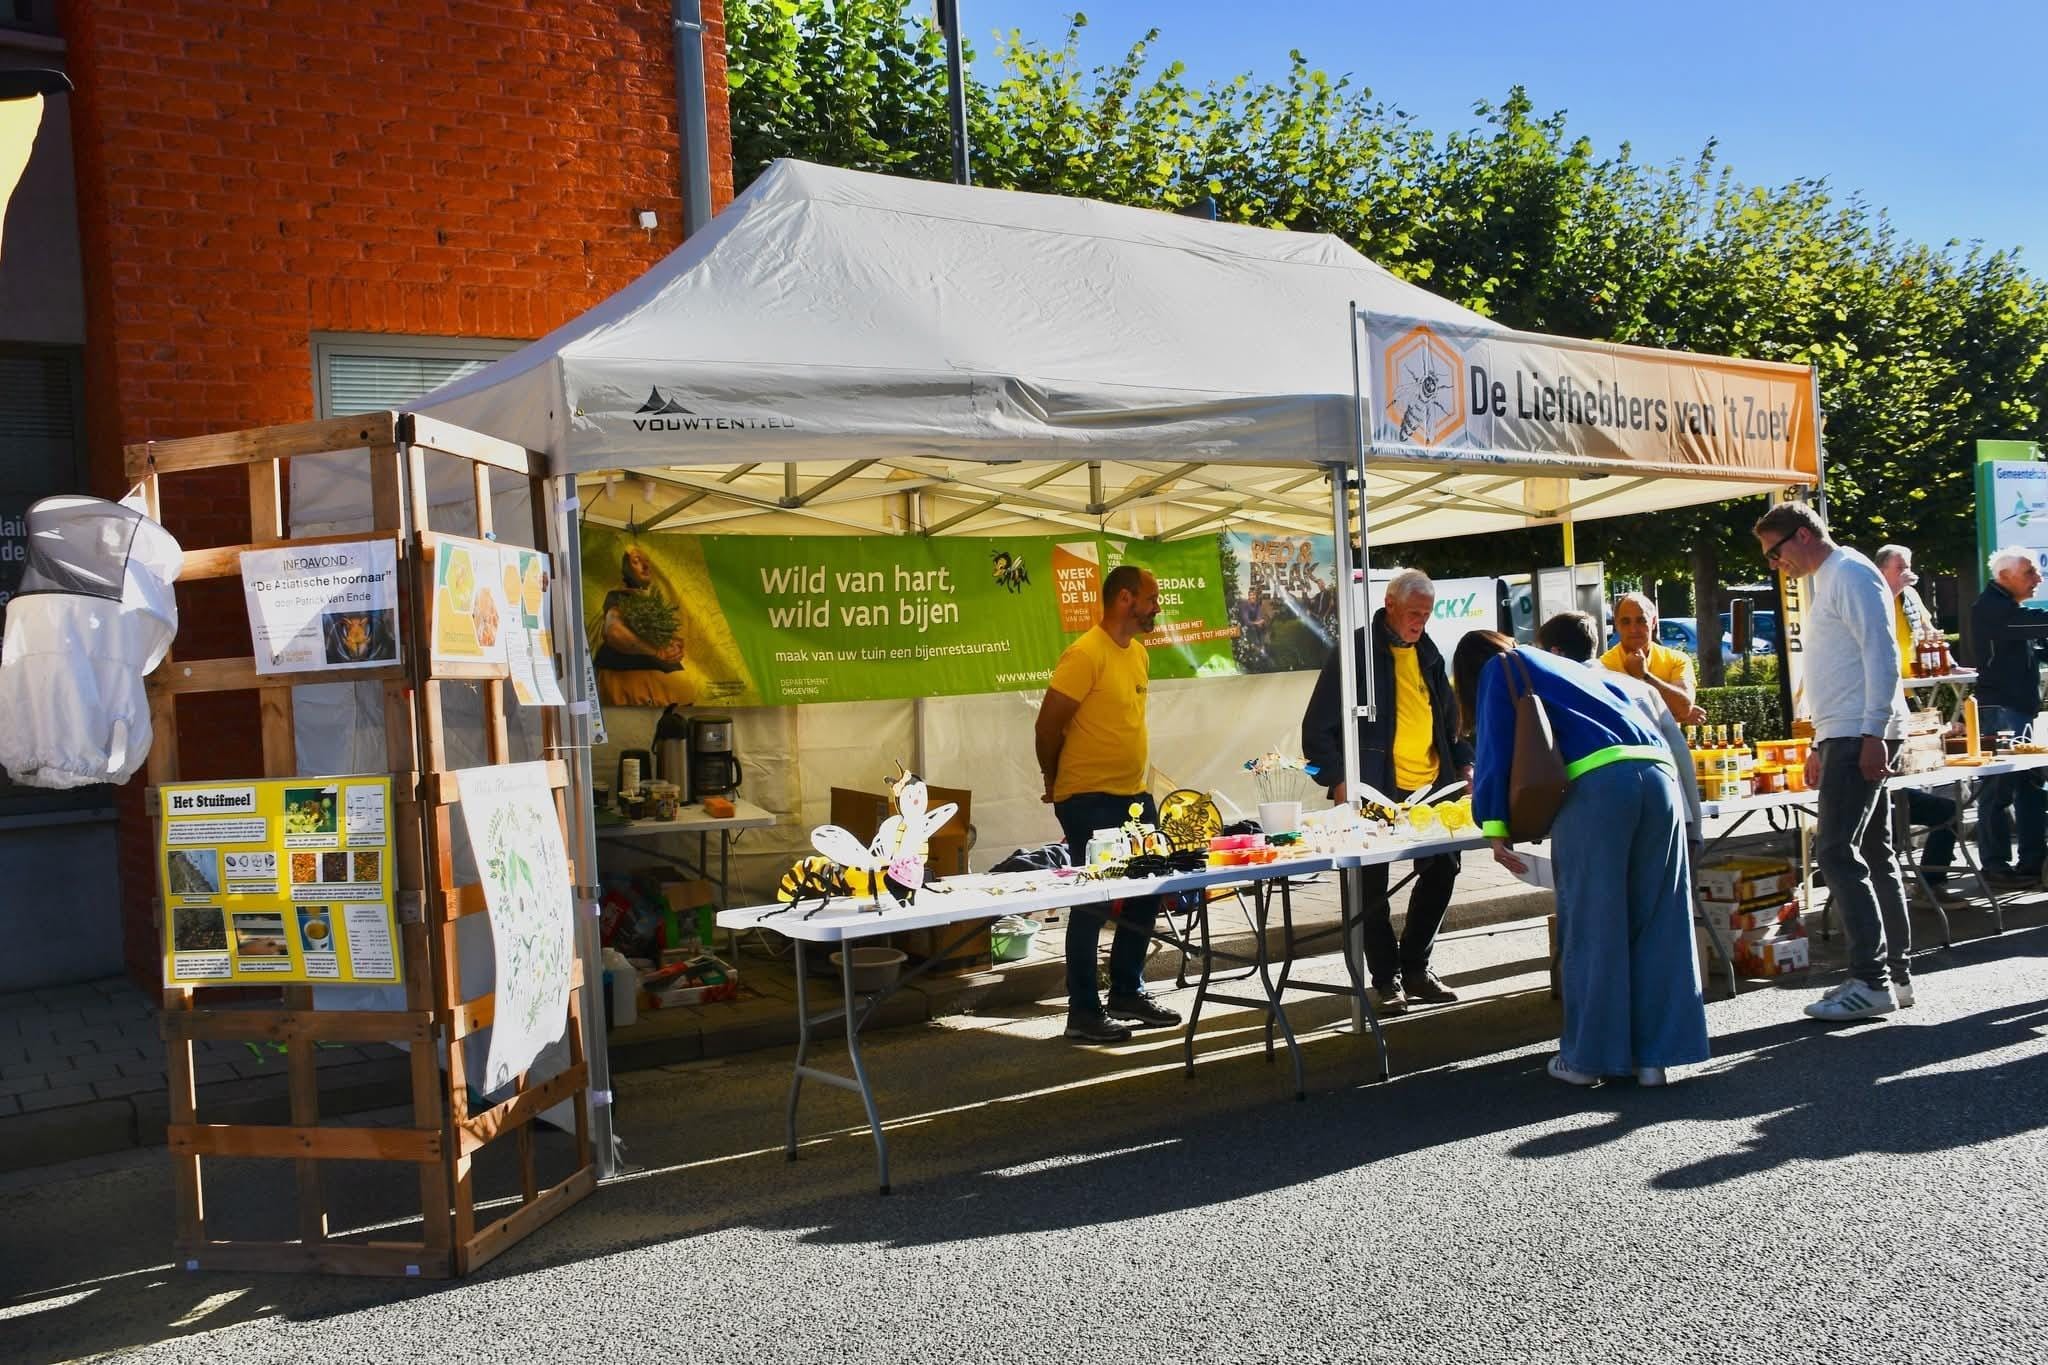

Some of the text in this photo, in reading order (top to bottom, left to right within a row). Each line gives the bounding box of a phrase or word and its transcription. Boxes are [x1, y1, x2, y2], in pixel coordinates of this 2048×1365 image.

[1470, 364, 1507, 418] De
[1516, 369, 1668, 434] Liefhebbers
[1675, 399, 1716, 438] van
[1745, 394, 1790, 442] Zoet
[633, 415, 795, 432] VOUWTENT.EU
[760, 564, 956, 596] Wild van hart,
[1057, 567, 1095, 581] WEEK
[275, 577, 330, 591] Aziatische
[1059, 580, 1087, 592] VAN
[1197, 576, 1207, 589] &
[346, 591, 372, 602] Ende
[1062, 591, 1097, 604] DE BIJ
[768, 597, 960, 633] wild van bijen
[776, 639, 1011, 662] maak van uw tuin een bijenrestaurant!
[780, 677, 830, 688] DEPARTEMENT
[781, 687, 820, 696] OMGEVING
[173, 793, 251, 809] Het Stuifmeel
